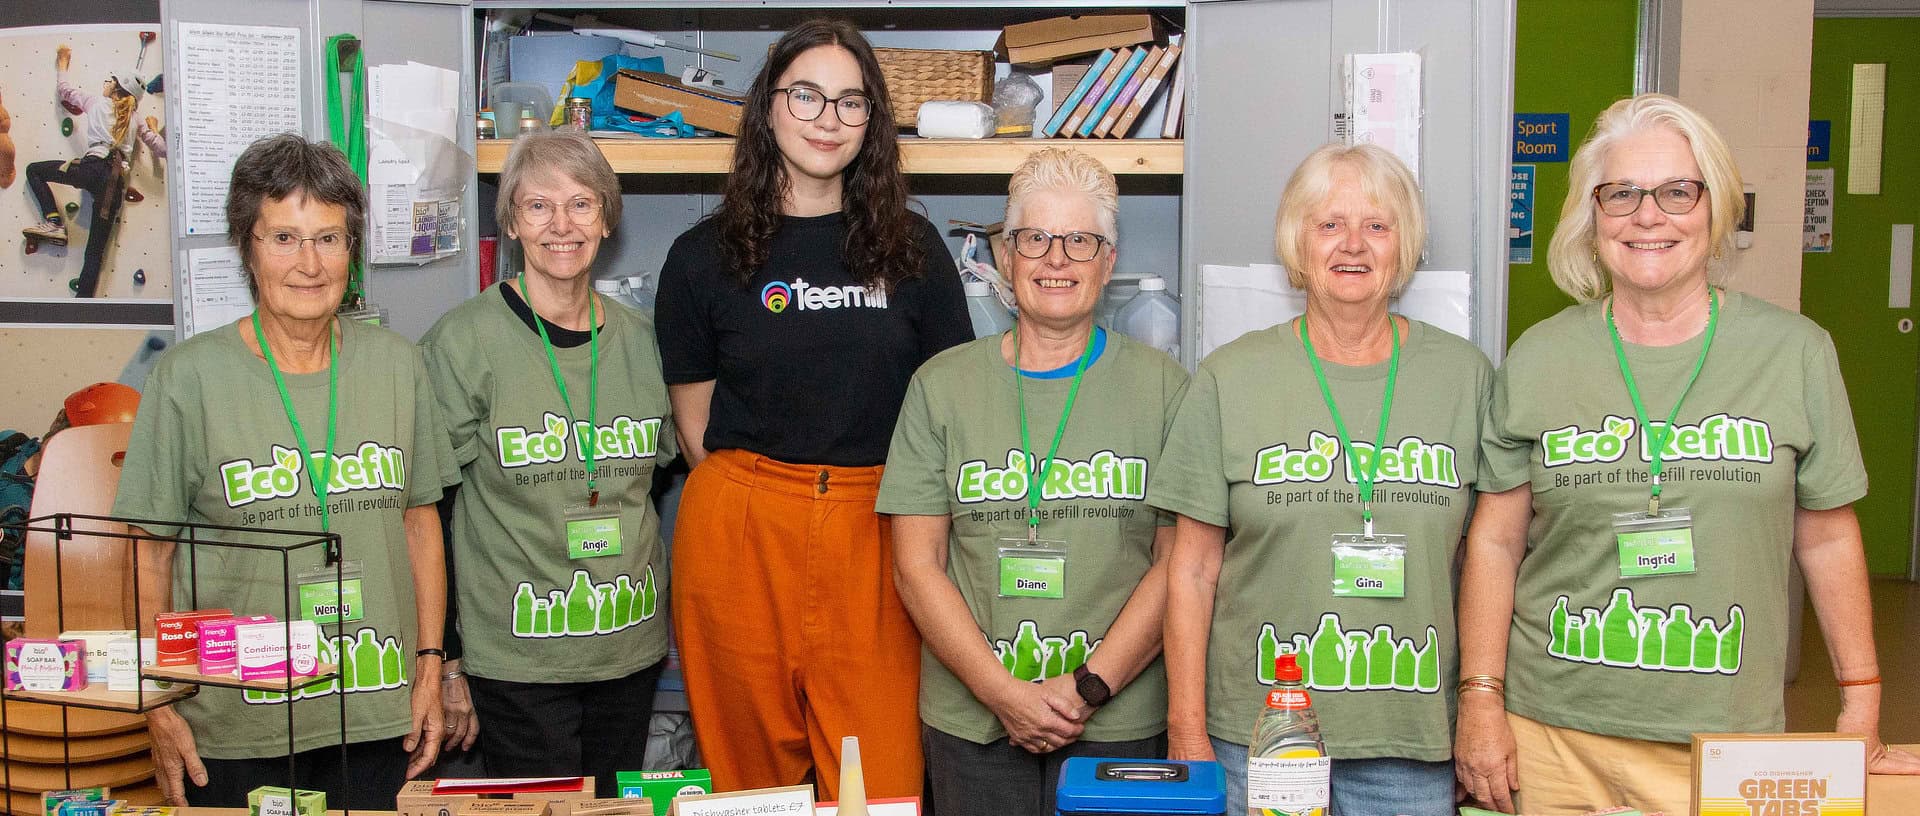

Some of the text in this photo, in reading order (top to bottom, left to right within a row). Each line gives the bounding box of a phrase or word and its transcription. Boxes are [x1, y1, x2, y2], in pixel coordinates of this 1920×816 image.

[1518, 121, 1557, 137] Sport
[1517, 141, 1557, 154] Room
[790, 277, 888, 310] teemill
[500, 419, 661, 464] Eco Refill
[1546, 416, 1770, 463] Eco Refill
[1256, 440, 1458, 484] Eco Refill
[222, 445, 405, 504] Eco Refill
[515, 473, 529, 486] Be
[533, 471, 555, 487] part
[557, 467, 567, 480] of
[570, 466, 585, 480] the
[958, 454, 1144, 500] Eco Refill
[1555, 466, 1761, 488] Be part of the efill revolution
[1267, 488, 1450, 508] Be part of the rfill revolution
[259, 509, 284, 525] part
[289, 504, 301, 518] of
[304, 503, 322, 517] the
[326, 498, 354, 514] refill
[971, 509, 984, 522] Be
[987, 507, 1010, 523] part
[1014, 506, 1026, 520] of
[1052, 505, 1079, 519] refill
[1083, 505, 1134, 519] revolution
[582, 539, 608, 553] Angie
[1638, 552, 1675, 569] Ingrid
[1017, 579, 1047, 589] Diane
[1356, 577, 1382, 588] Gina
[315, 604, 350, 616] Weny
[162, 632, 183, 641] Rose
[111, 658, 151, 666] Aloe Vra
[1738, 779, 1827, 799] GREEN
[753, 803, 785, 814] tablets
[789, 802, 803, 813] £7
[1747, 800, 1819, 816] TABS
